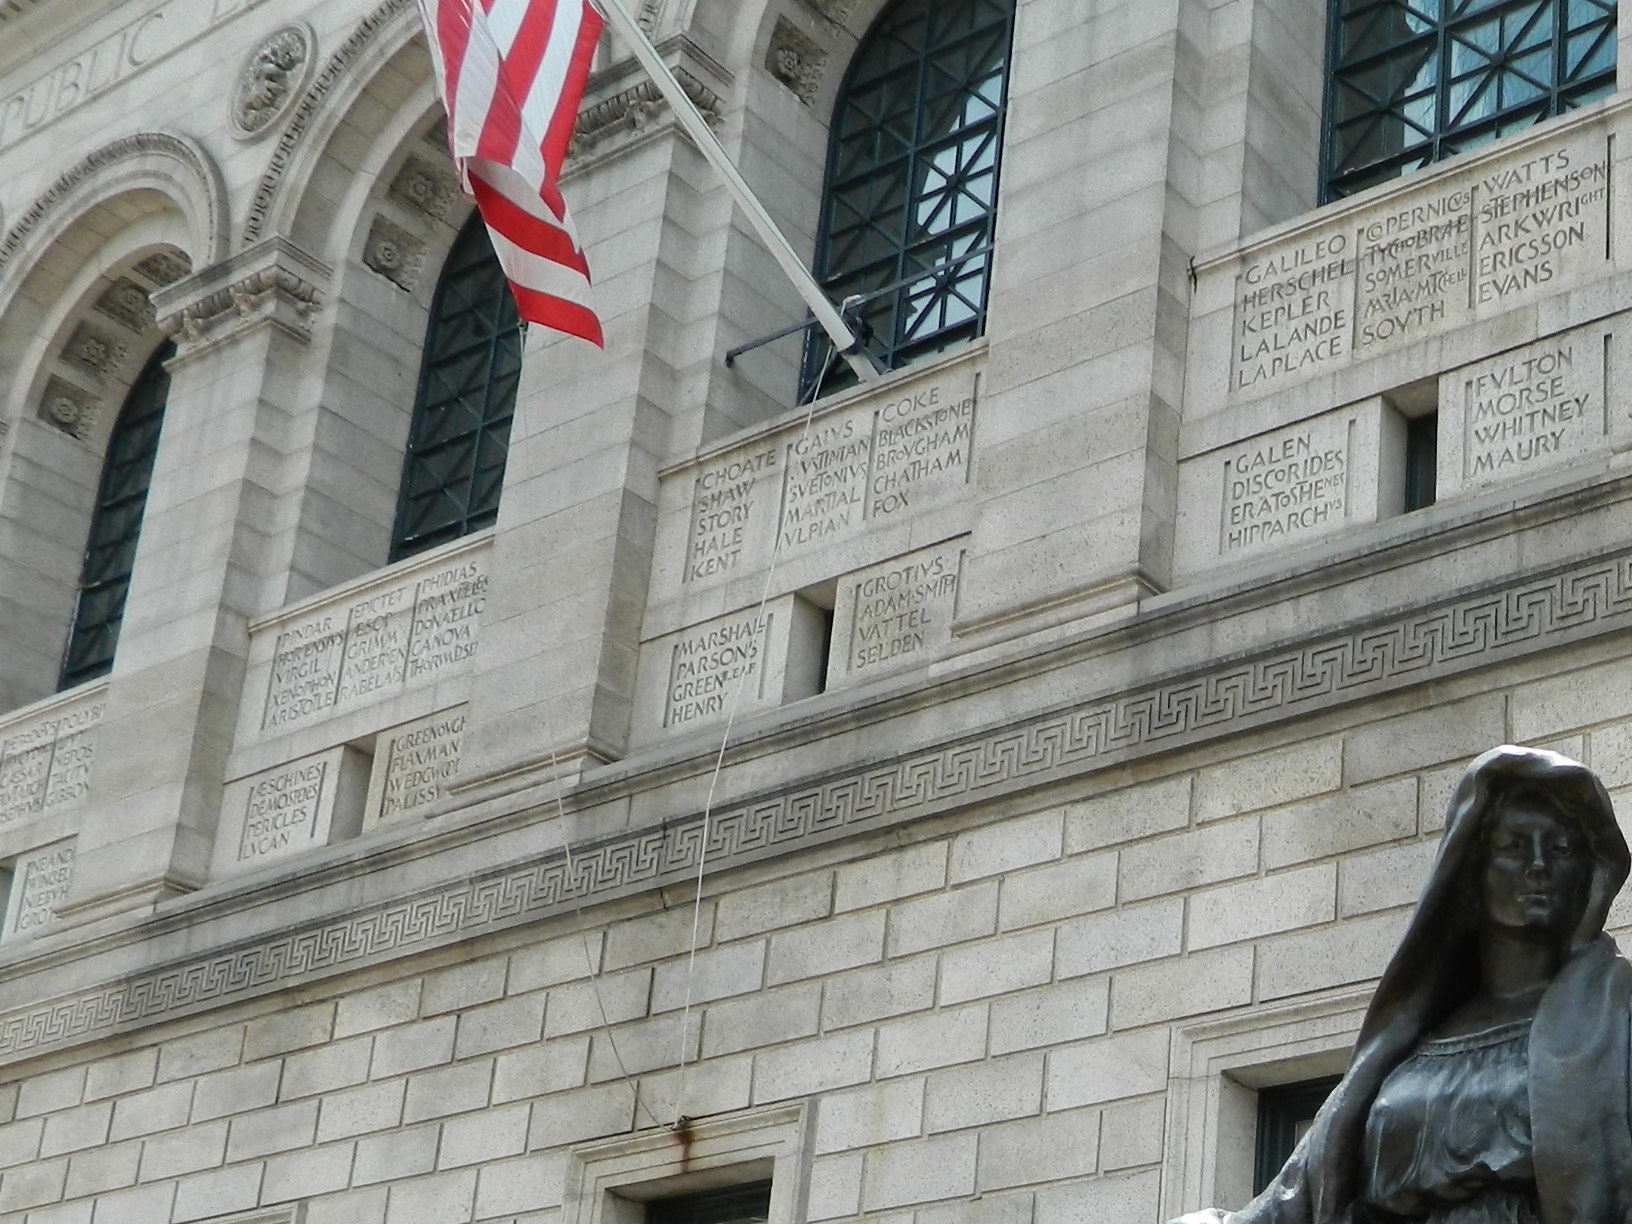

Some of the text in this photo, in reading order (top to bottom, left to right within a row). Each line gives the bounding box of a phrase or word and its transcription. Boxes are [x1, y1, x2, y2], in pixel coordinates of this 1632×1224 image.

[0, 12, 164, 143] PUBLIC
[1480, 160, 1606, 224] STEPHENSON
[1482, 149, 1569, 194] WATTS
[1479, 187, 1605, 251] ARKWRIGHT
[1245, 234, 1346, 285] GALILEO
[1365, 241, 1469, 294] SOMERVILLE
[1479, 222, 1584, 277] ERICSSON
[1243, 258, 1354, 313] HERSCHEL
[1477, 260, 1553, 304] EVANS
[1242, 290, 1331, 337] KEPLER
[1240, 309, 1346, 362] LALANDE
[1239, 335, 1342, 388] LAPLACE
[1477, 346, 1573, 397] FVLTON
[882, 387, 939, 423] COKE
[1475, 376, 1565, 423] MORSE
[1475, 393, 1590, 444] WHITNEY
[878, 399, 971, 448] BLACKSTONE
[876, 422, 970, 471] BROVGHAM
[1236, 433, 1311, 474] GALEN
[1472, 427, 1565, 476] MAURY
[702, 449, 776, 490] CHOATE
[873, 449, 962, 495] CHATHAM
[1233, 450, 1344, 500] DISCORIDES
[699, 477, 755, 513] SHAW
[785, 486, 861, 528] MARTIAL
[873, 490, 910, 518] FOX
[697, 501, 754, 536] STORY
[693, 527, 743, 559] HALE
[421, 560, 478, 594] PHIDIAS
[690, 549, 741, 582] KENT
[862, 556, 944, 599] GROTIVS
[280, 616, 333, 648] PINDAR
[411, 624, 472, 657] CANOVA
[678, 616, 767, 658] MARSHALL
[858, 608, 932, 643] VATTEL
[676, 640, 757, 680] PARSONS
[856, 631, 925, 669] SELDEN
[275, 658, 322, 685] VIRGIL
[340, 665, 404, 701] RABELAIS
[672, 662, 756, 704] GREENLEAF
[671, 692, 727, 725] HENRY
[391, 739, 462, 774] FLAXMAN
[246, 806, 308, 840] PERICLES
